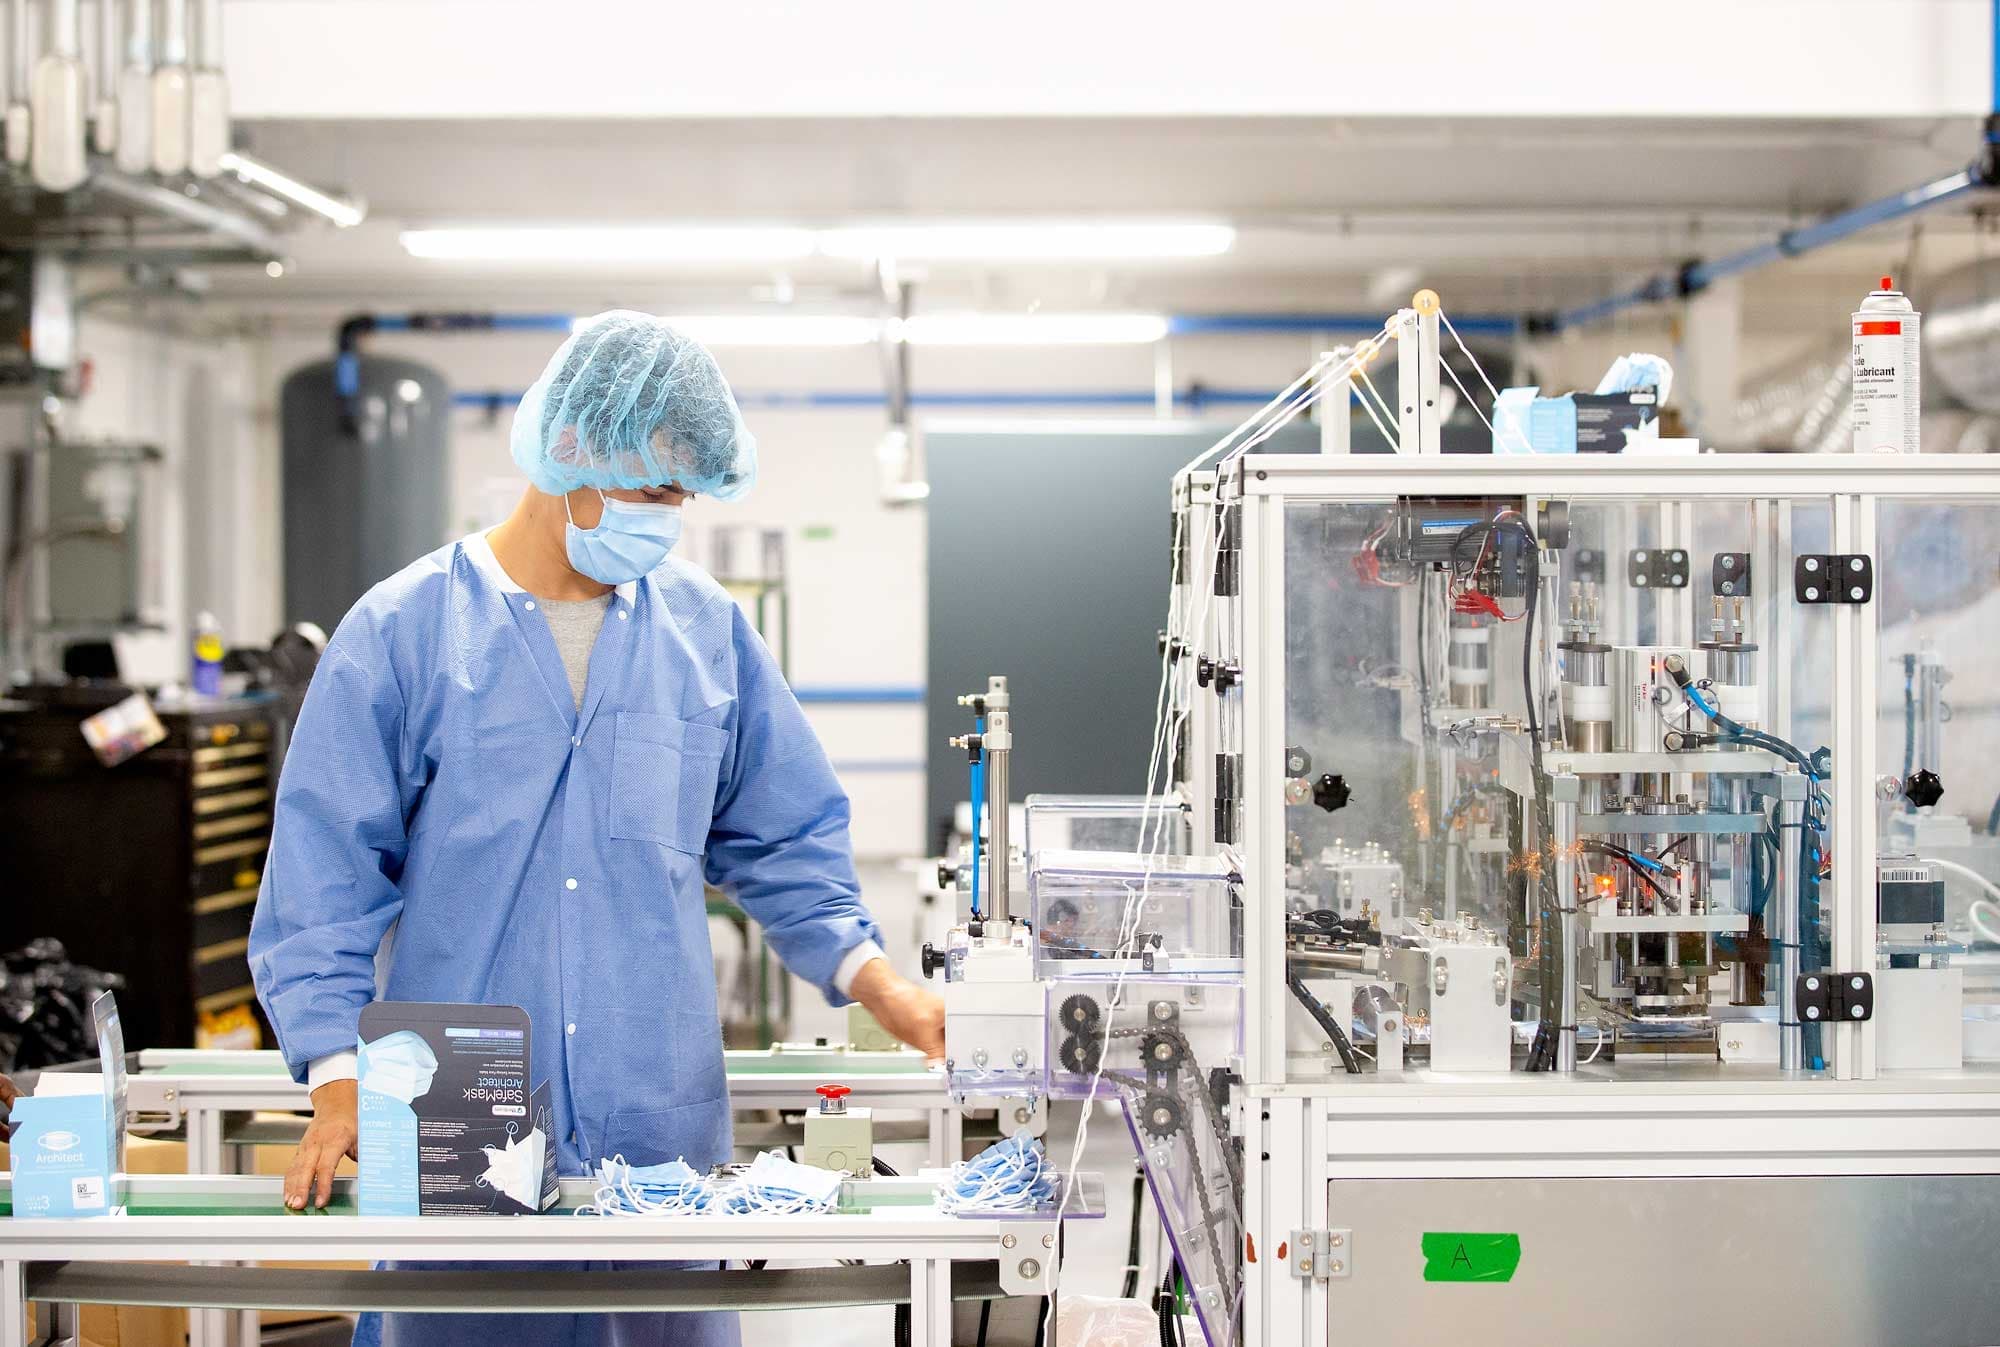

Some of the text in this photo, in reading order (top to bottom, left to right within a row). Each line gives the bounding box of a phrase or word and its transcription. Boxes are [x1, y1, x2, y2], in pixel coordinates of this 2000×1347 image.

[1857, 367, 1895, 376] Lubricant
[477, 1077, 523, 1089] Architect
[462, 1088, 523, 1103] SafeMask
[35, 1152, 84, 1163] Architect
[1451, 1240, 1472, 1269] A
